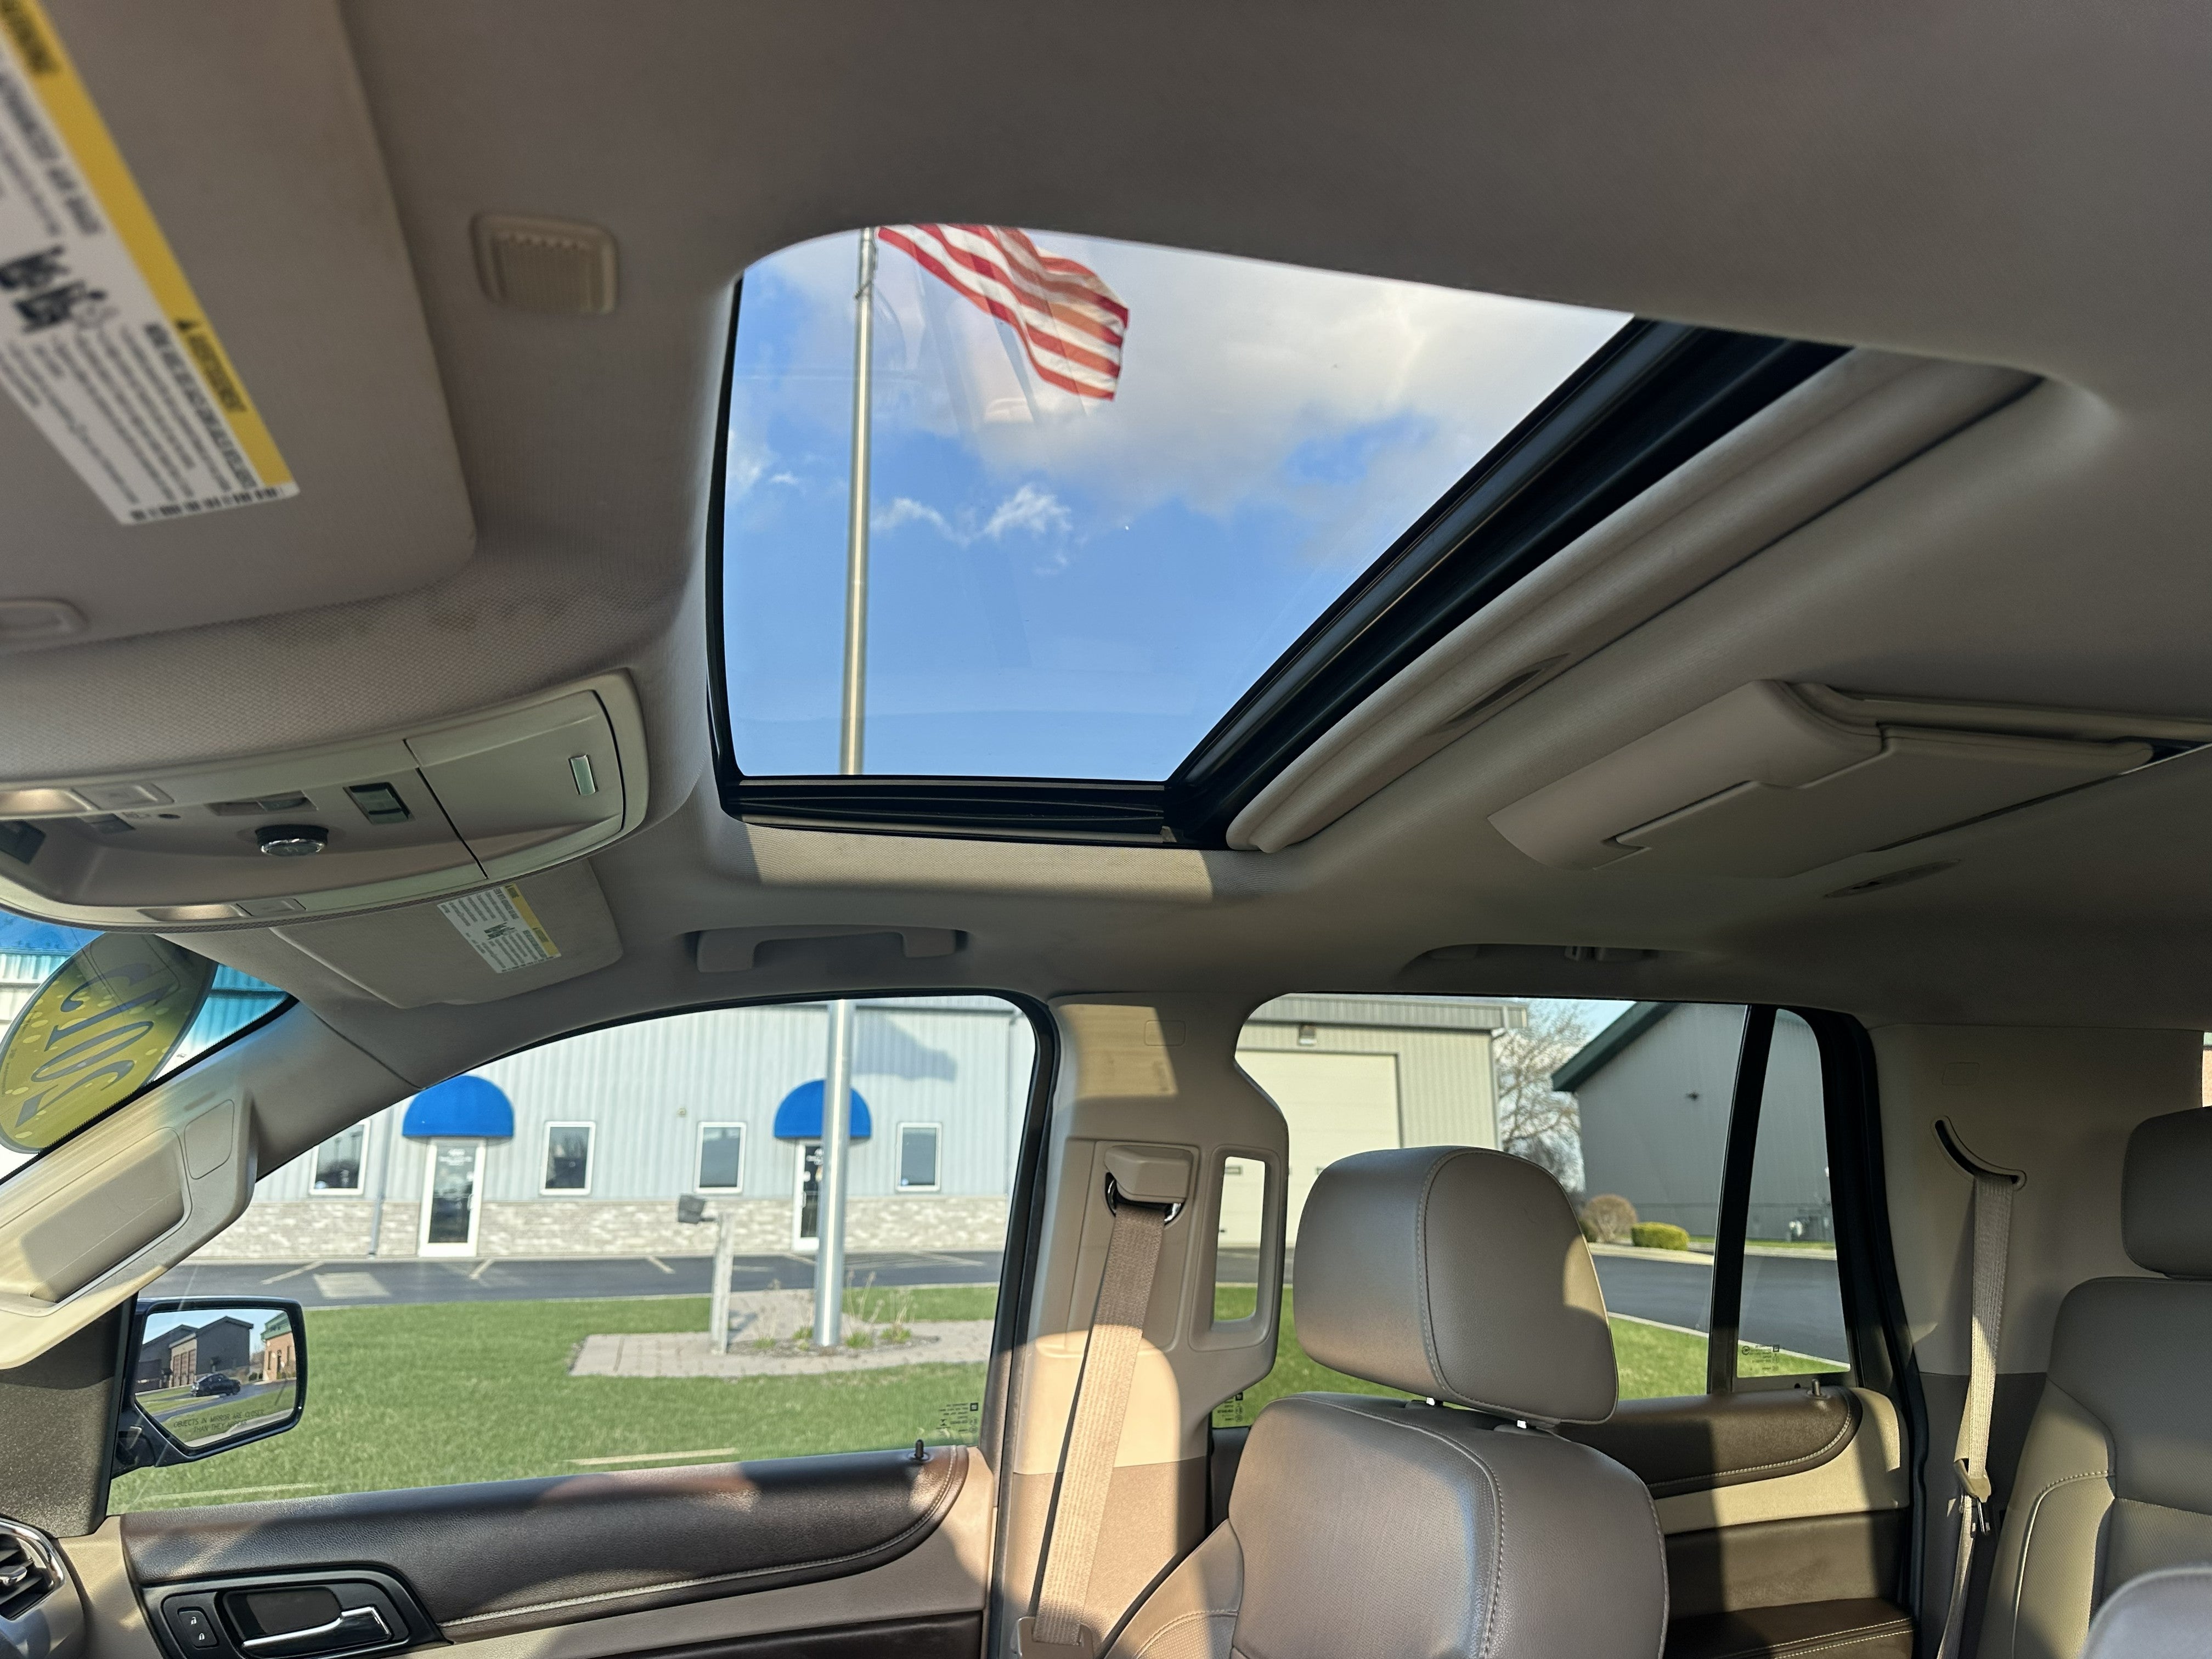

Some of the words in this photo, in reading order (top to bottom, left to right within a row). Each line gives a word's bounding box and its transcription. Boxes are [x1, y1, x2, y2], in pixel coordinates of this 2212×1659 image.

[173, 1418, 199, 1427] OBJECTS
[210, 1414, 230, 1423] MIRROR
[245, 1409, 264, 1418] CLOSER
